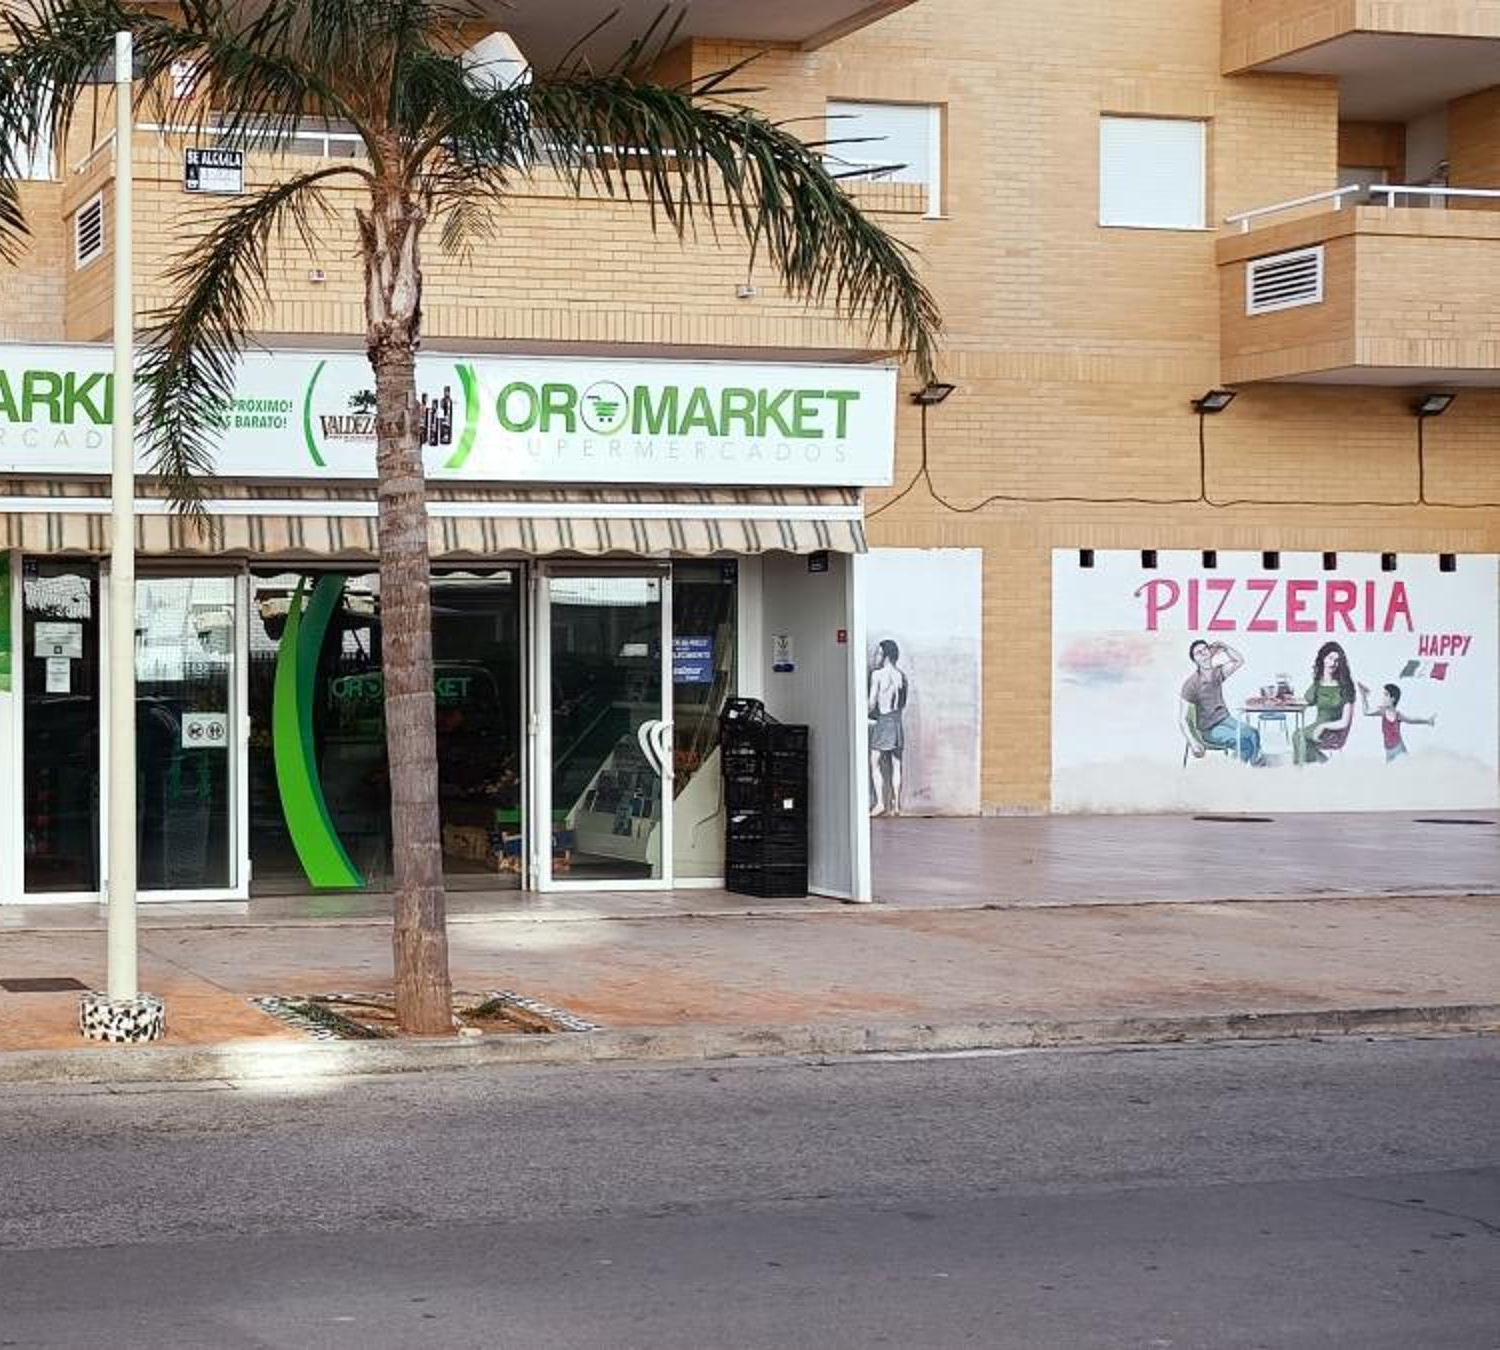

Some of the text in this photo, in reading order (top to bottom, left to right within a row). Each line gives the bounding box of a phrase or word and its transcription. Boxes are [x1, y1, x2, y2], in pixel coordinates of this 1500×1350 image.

[187, 150, 199, 165] SE
[235, 415, 287, 429] BARATO!
[1134, 578, 1414, 633] PIZZERIA
[1417, 634, 1472, 658] HAPPY
